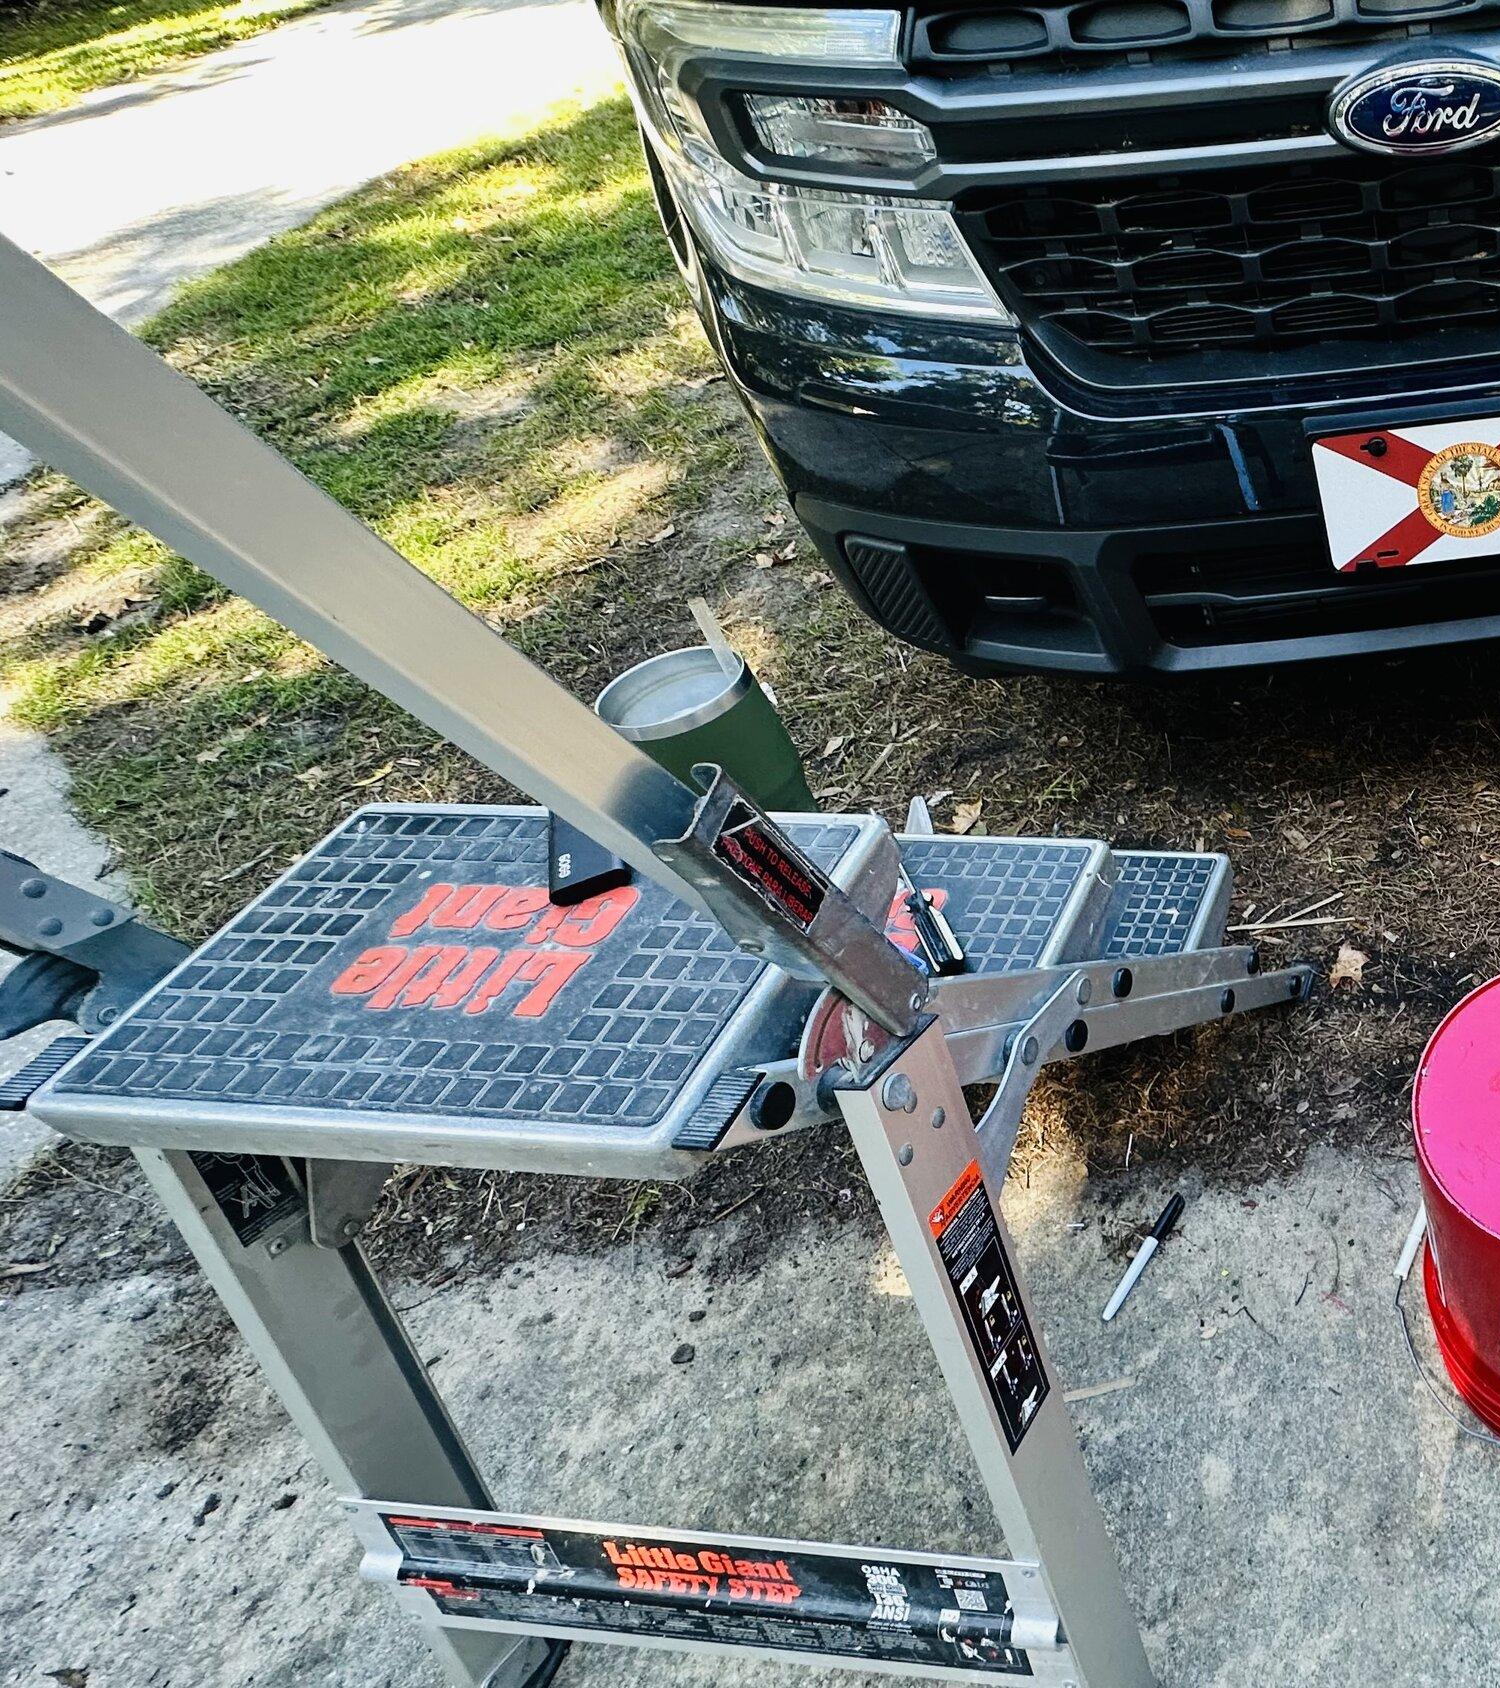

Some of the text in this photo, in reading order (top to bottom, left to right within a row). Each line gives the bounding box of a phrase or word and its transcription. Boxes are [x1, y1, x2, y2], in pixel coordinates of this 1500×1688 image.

[1382, 84, 1481, 137] Ford
[1449, 446, 1467, 456] THE
[1471, 446, 1498, 459] STATE
[744, 826, 812, 898] PUSH TO RELEASE
[389, 883, 640, 948] Giant
[330, 946, 593, 1018] Little
[602, 1541, 794, 1581] Little Giant
[860, 1564, 901, 1578] OSHA
[616, 1567, 802, 1605] SAFETY STEP
[870, 1604, 911, 1622] ANSI
